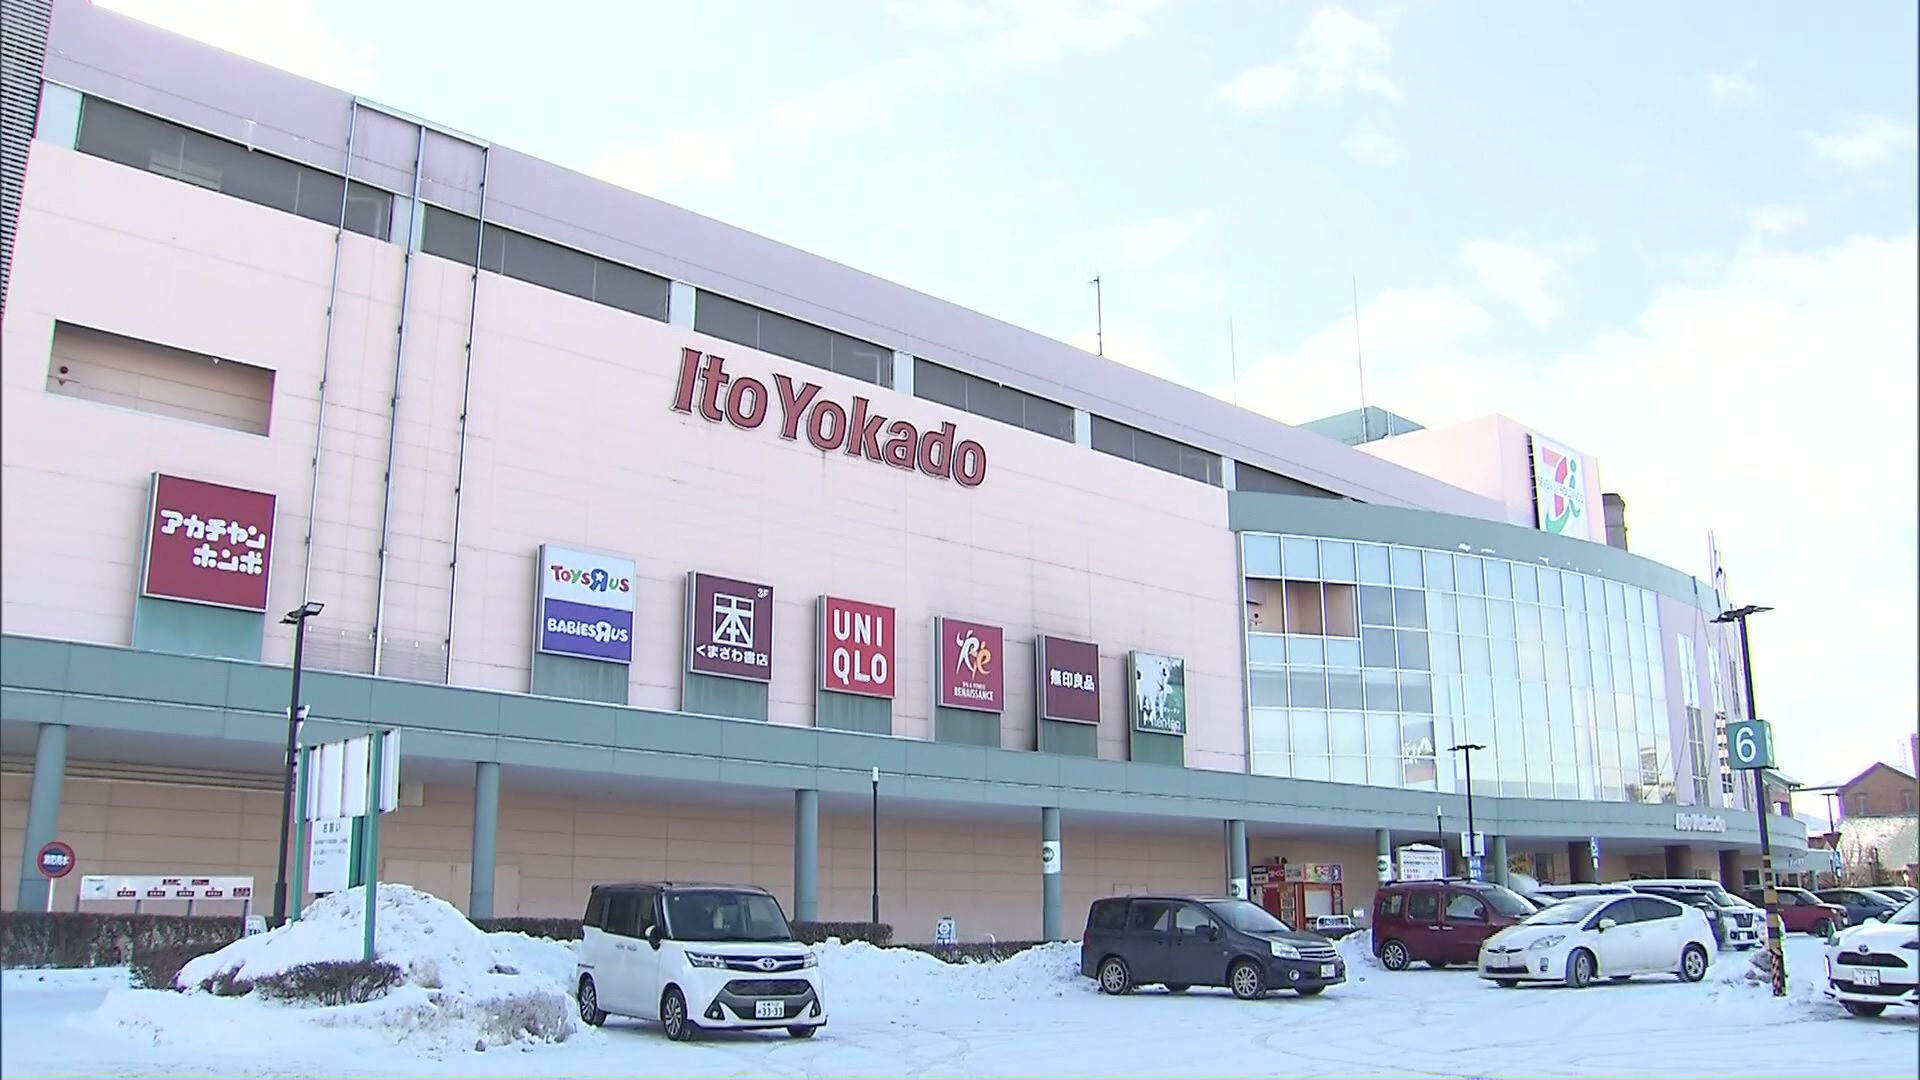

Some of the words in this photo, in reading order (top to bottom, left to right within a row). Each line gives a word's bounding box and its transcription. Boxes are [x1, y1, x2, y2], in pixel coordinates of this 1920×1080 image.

[160, 509, 266, 550] アカチャン
[757, 588, 769, 598] 3F
[833, 609, 883, 647] UNI
[696, 644, 769, 667] くまざわ書店
[833, 647, 888, 685] QLO
[953, 686, 993, 702] RENAISSANCE
[1050, 668, 1095, 692] 無印良品
[1736, 726, 1756, 763] 6
